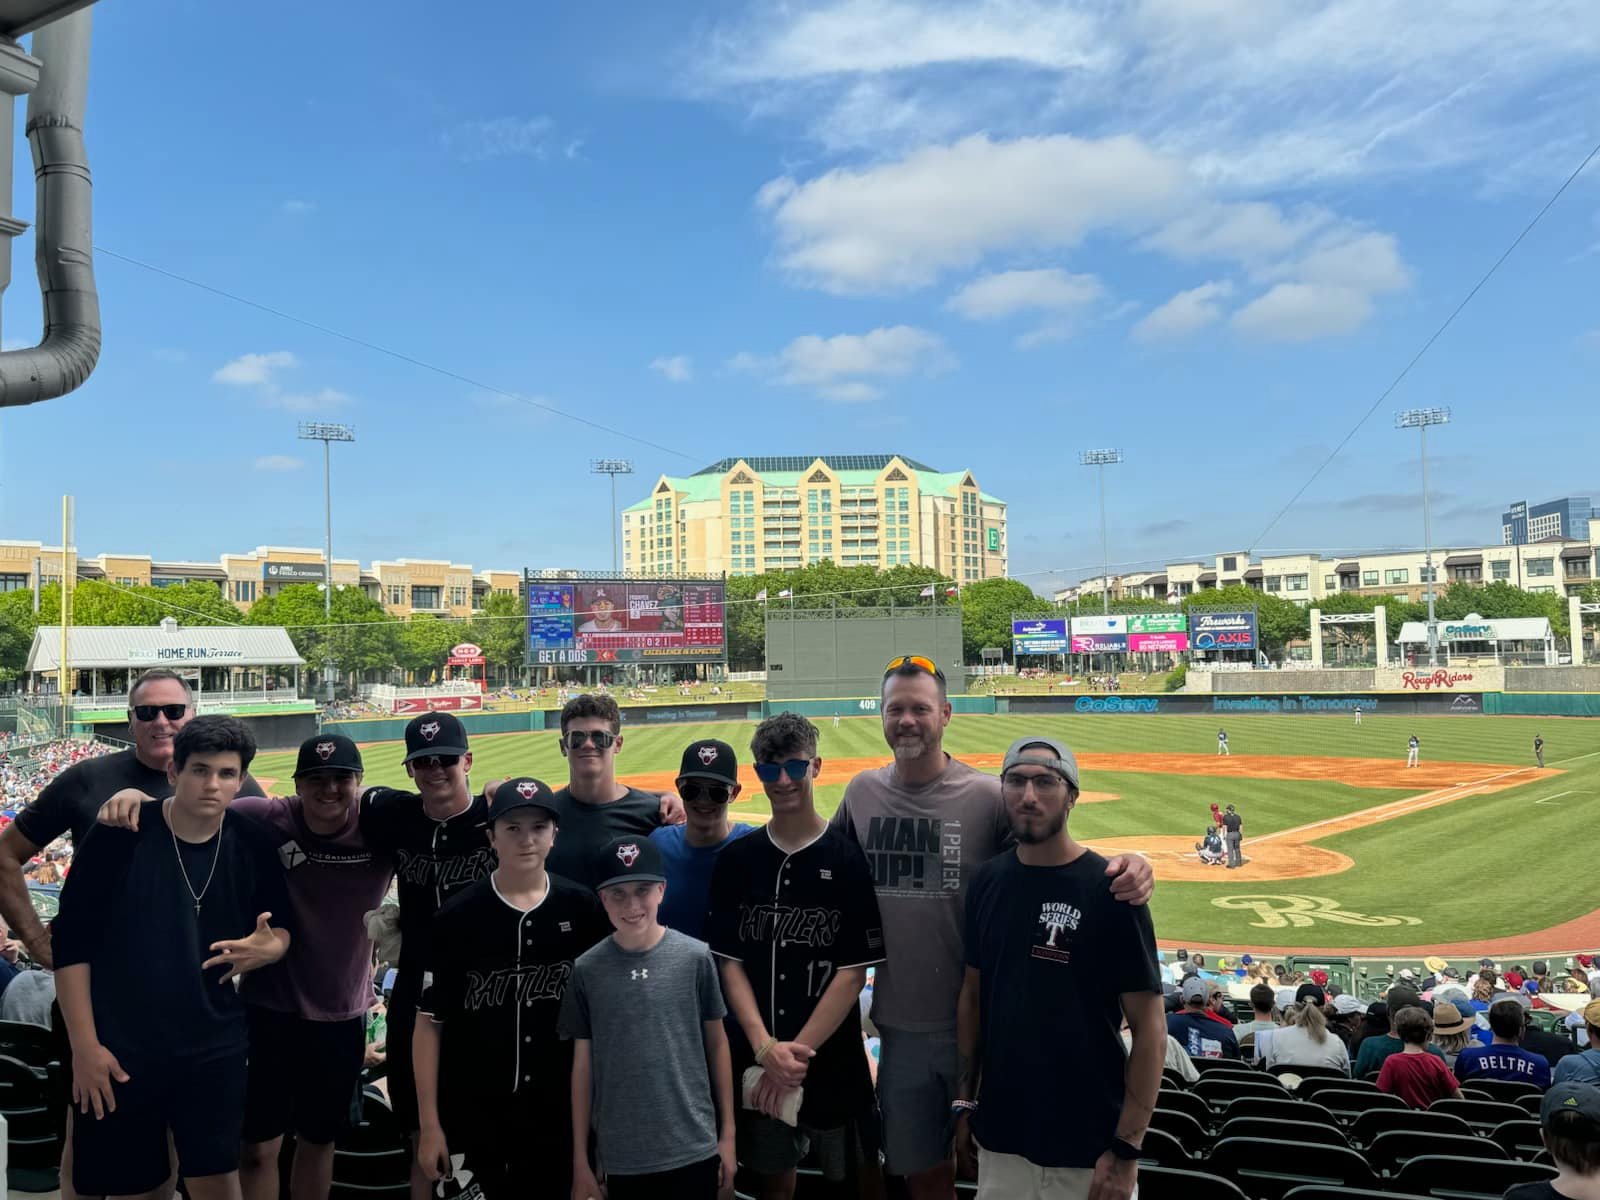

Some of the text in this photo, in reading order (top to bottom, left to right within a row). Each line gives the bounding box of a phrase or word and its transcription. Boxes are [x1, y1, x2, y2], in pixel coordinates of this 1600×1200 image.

[629, 600, 658, 610] CHAVEZ
[655, 637, 661, 646] 2
[1095, 642, 1126, 650] RELIABLE
[1216, 633, 1251, 643] AXIS
[158, 648, 184, 659] HOME
[187, 648, 207, 658] RUN
[207, 647, 242, 658] Terrace
[538, 650, 587, 663] GET A DOS
[859, 699, 876, 709] 409
[1075, 696, 1157, 712] CoServ
[1213, 696, 1279, 711] Investing
[1299, 696, 1378, 709] Tomorrow
[865, 816, 940, 853] MAN
[942, 834, 961, 889] PETER
[869, 853, 924, 888] UP!
[1042, 902, 1082, 920] WORLD
[738, 904, 841, 947] RATTLERS
[1038, 911, 1079, 930] SERIES
[464, 960, 573, 1011] RATTLER
[807, 960, 832, 997] 17
[1479, 1055, 1535, 1075] BELTRE
